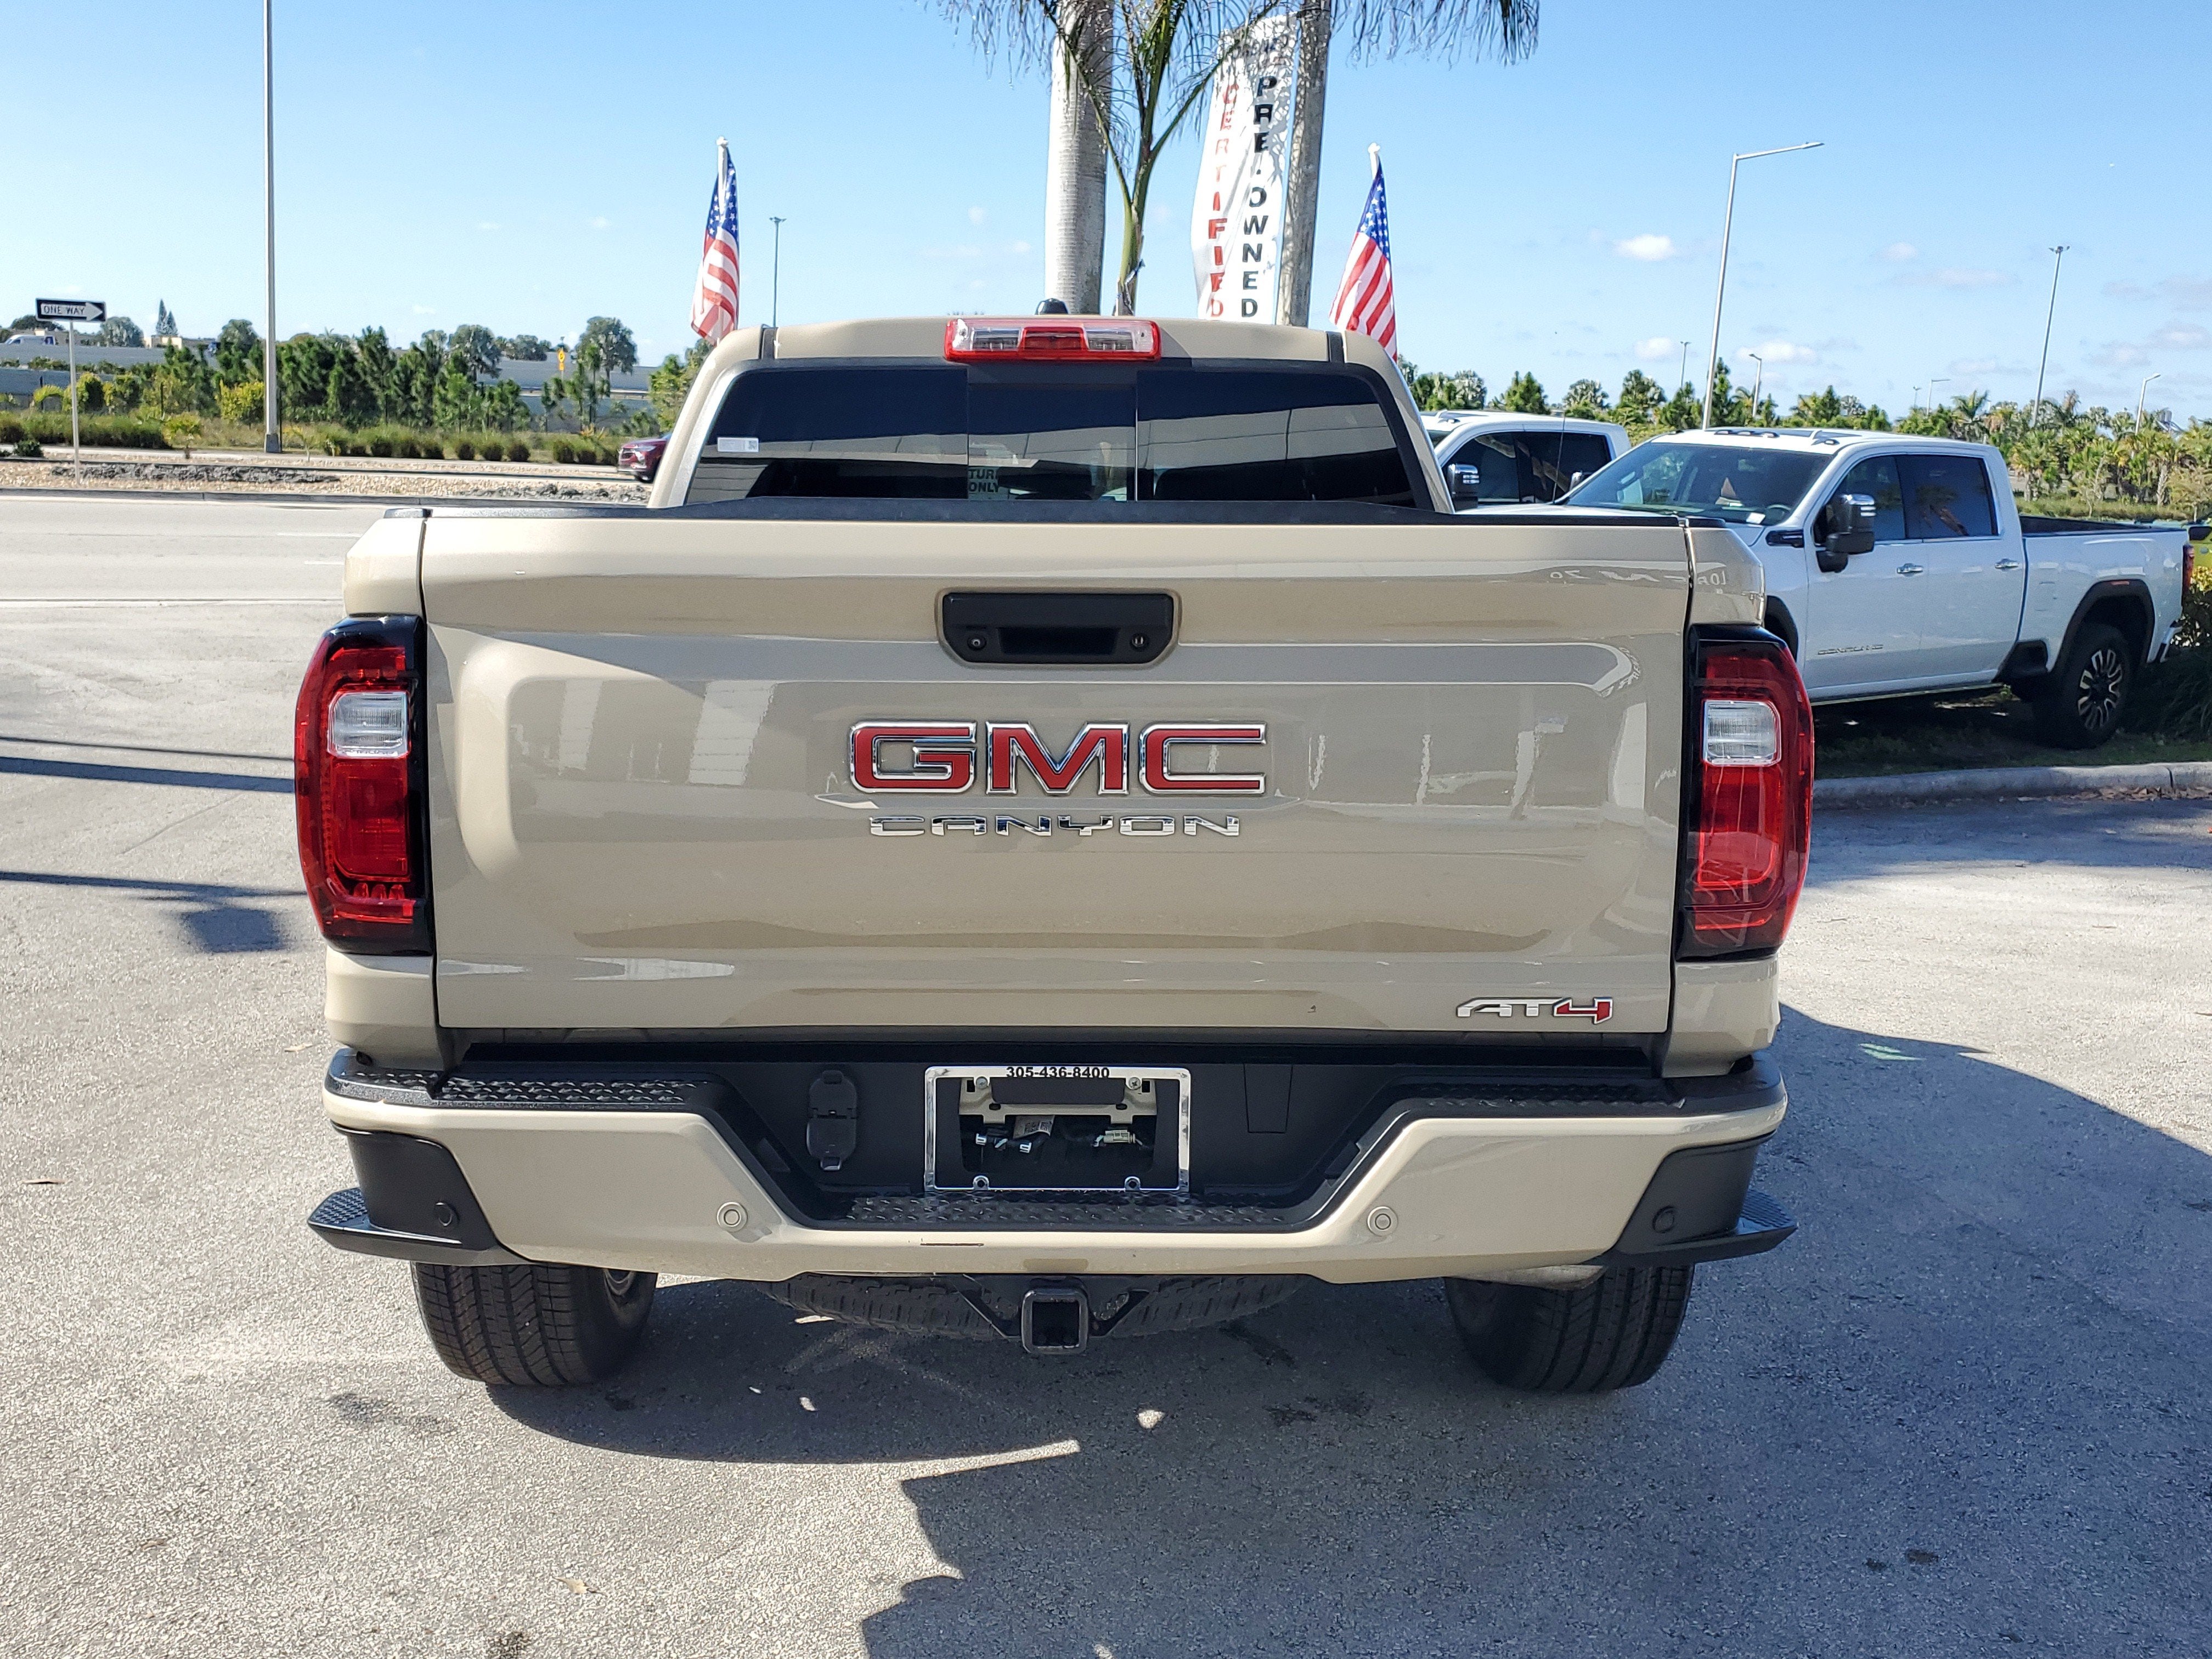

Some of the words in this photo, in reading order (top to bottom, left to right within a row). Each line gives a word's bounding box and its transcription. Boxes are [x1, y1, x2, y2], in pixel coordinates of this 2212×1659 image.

[1207, 83, 1239, 317] CERTIFIED
[44, 305, 62, 314] ONE
[66, 307, 85, 315] WAY
[969, 469, 997, 479] TUR
[969, 482, 998, 493] ONLY
[850, 720, 1266, 795] GMC
[870, 815, 1239, 837] CANYON
[1456, 996, 1613, 1024] AT4
[1006, 1066, 1110, 1078] 305-436-8400
